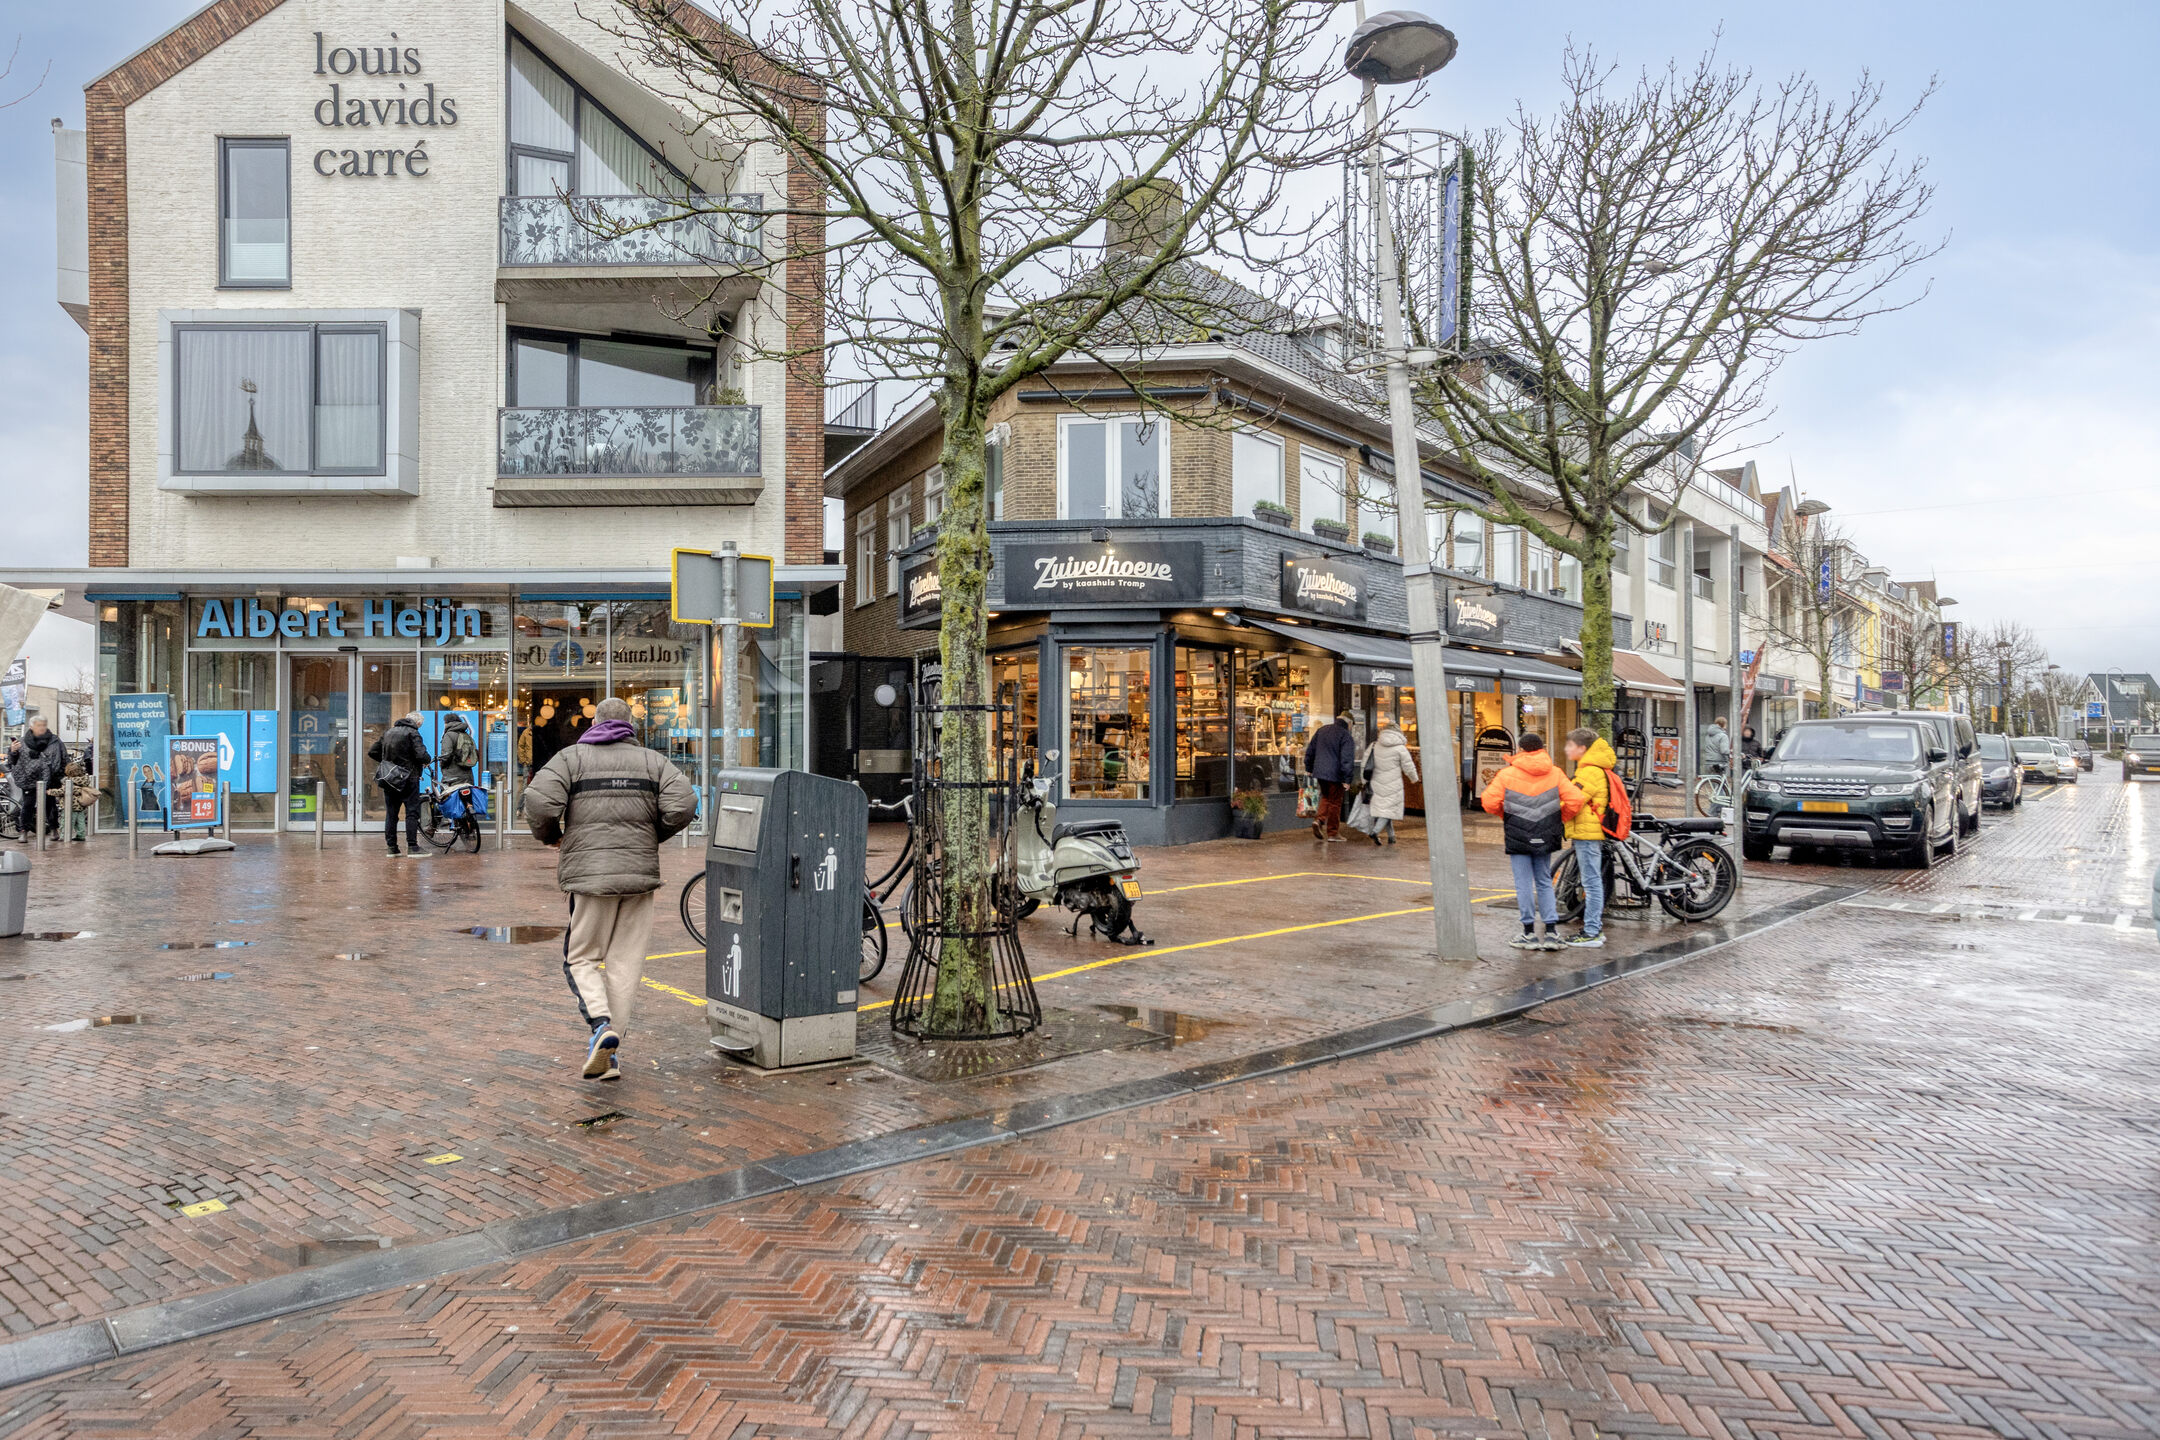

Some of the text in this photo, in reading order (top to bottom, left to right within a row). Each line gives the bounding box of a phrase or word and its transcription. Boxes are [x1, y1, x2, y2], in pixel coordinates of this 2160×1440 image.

[313, 32, 421, 75] louis
[314, 83, 458, 126] davids
[313, 140, 429, 176] carré
[1033, 556, 1172, 590] Zuivelhoeve
[1063, 578, 1145, 590] by kaashuis Tromp
[1296, 568, 1357, 602] Zuivelhoeve
[197, 598, 481, 647] Albert Heijn
[1457, 600, 1497, 627] Zuivelhoeve
[115, 700, 163, 709] How about
[117, 720, 150, 730] money?
[118, 729, 151, 738] Make it
[181, 741, 215, 752] BONUS
